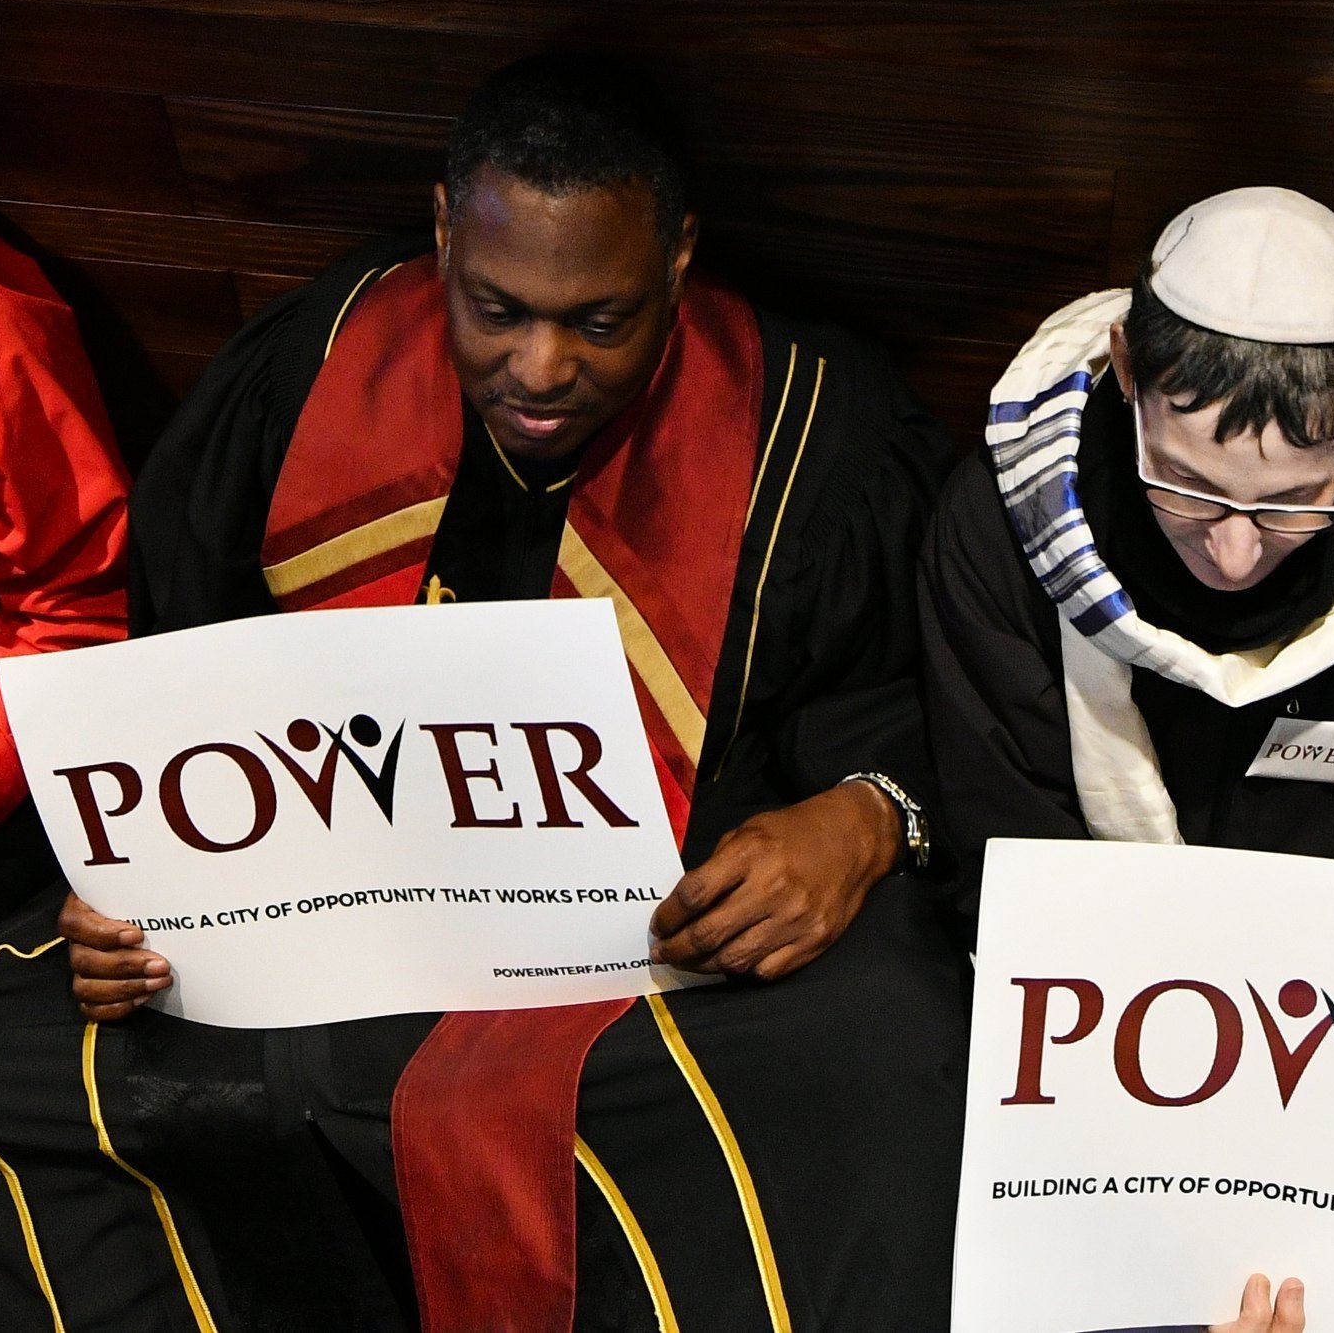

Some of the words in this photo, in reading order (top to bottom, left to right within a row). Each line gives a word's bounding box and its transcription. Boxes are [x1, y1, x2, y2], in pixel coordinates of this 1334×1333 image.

[53, 713, 641, 867] POWER
[199, 914, 215, 929] A
[216, 907, 260, 926] CITY
[264, 902, 293, 919] OF
[296, 887, 437, 914] OPPORTUNITY
[440, 888, 491, 904] THAT
[495, 888, 573, 904] WORKS
[575, 888, 619, 904] FOR
[623, 887, 662, 902] ALL
[991, 1176, 1098, 1200] BUILDING
[1102, 1176, 1119, 1194] A
[1123, 1176, 1175, 1194] CITY
[1178, 1176, 1210, 1194] OF
